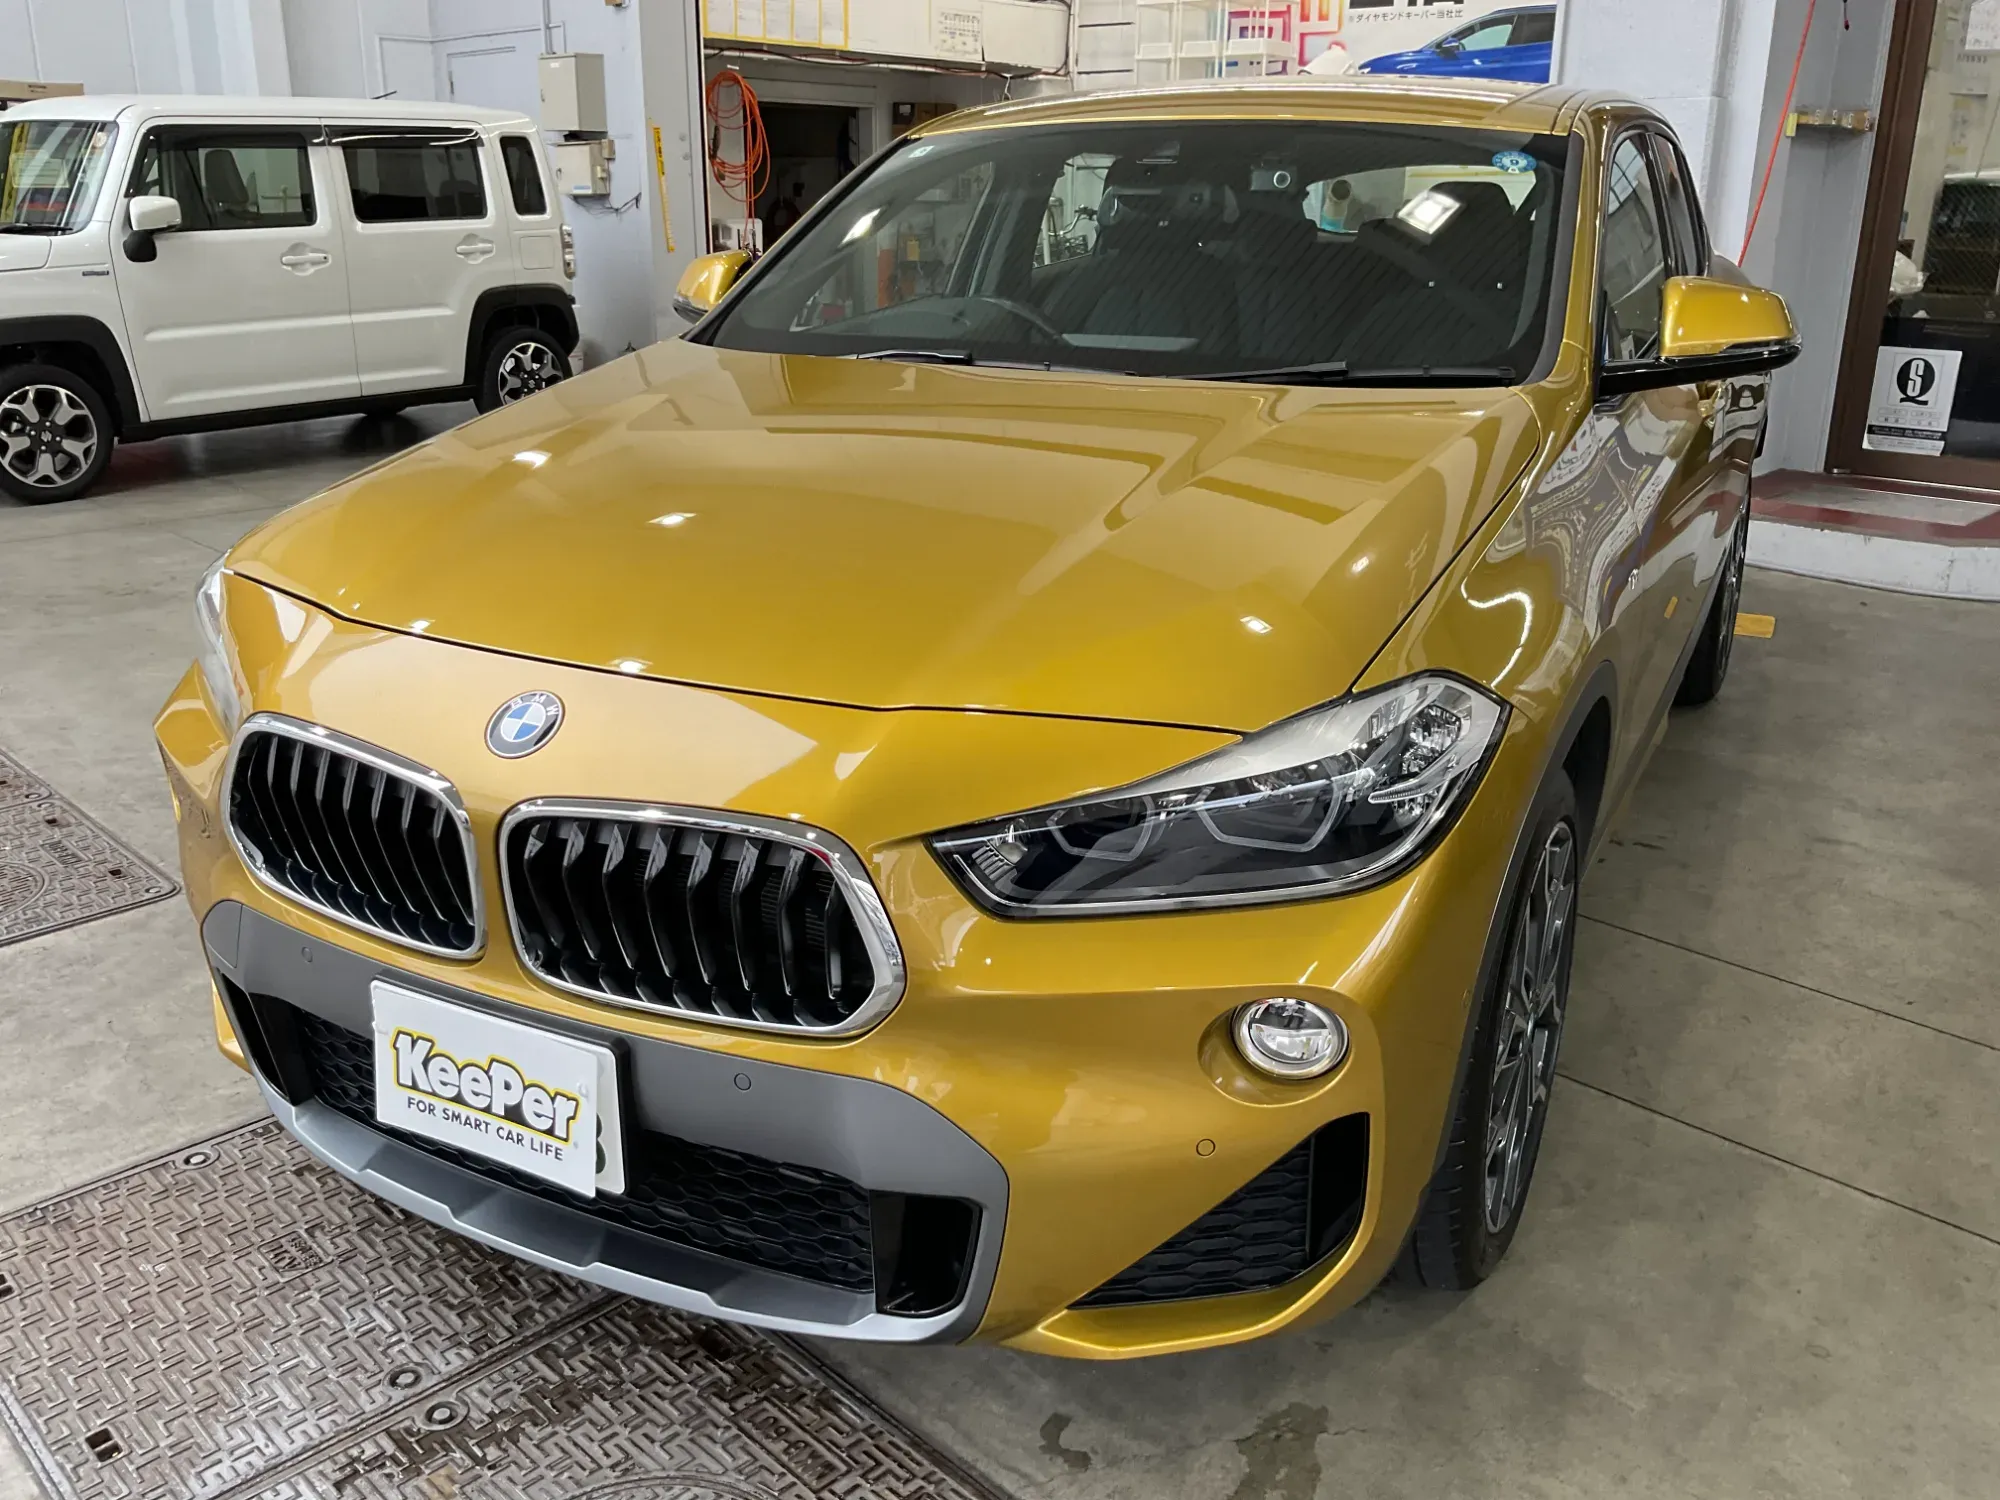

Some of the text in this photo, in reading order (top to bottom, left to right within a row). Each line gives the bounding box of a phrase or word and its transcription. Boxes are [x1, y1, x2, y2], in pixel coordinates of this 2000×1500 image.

[510, 692, 560, 716] BMW
[391, 1027, 581, 1144] KeePer
[407, 1096, 564, 1162] FOR SMART CAR LIFE
